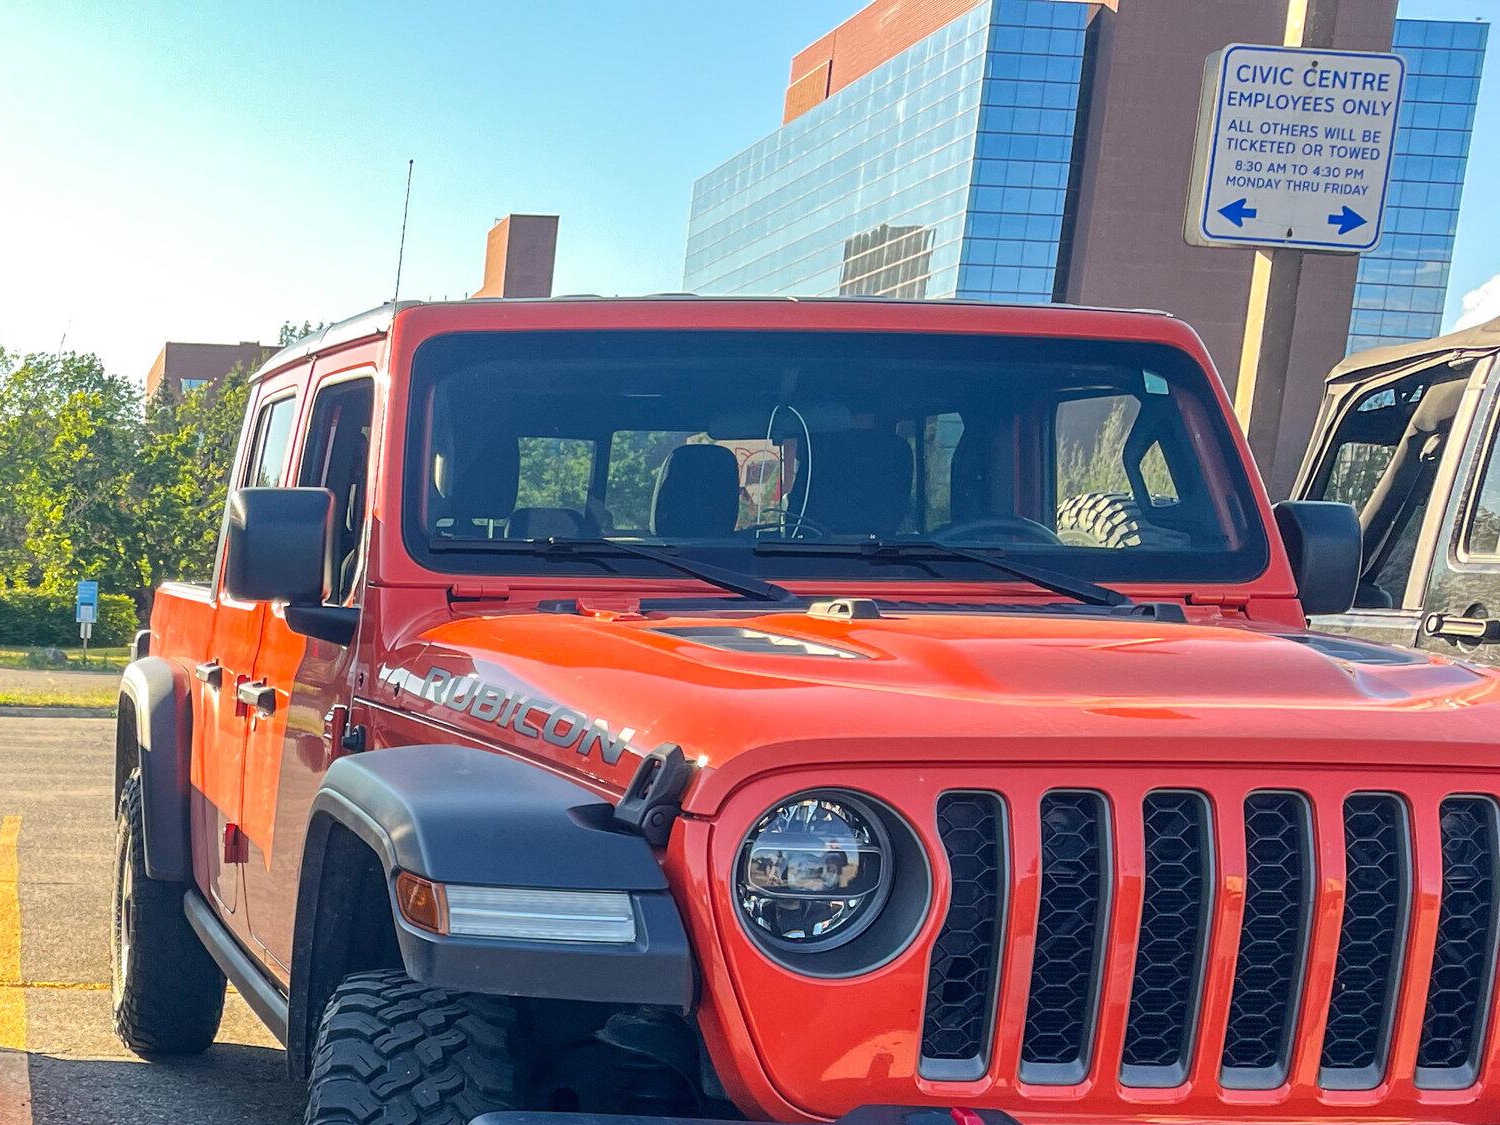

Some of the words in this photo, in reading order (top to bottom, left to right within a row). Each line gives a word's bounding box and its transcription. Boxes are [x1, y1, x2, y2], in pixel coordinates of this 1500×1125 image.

[1236, 64, 1294, 86] CIVIC
[1303, 68, 1390, 92] CENTRE
[1227, 91, 1334, 113] EMPLOYEES
[1343, 99, 1392, 117] ONLY
[1228, 119, 1254, 134] ALL
[1260, 122, 1318, 138] OTHERS
[1324, 128, 1355, 142] WILL
[1362, 130, 1382, 144] BE
[1227, 138, 1296, 155] TICKETED
[1301, 143, 1323, 157] OR
[1329, 145, 1380, 161] TOWED
[1235, 160, 1263, 172] 8:30
[1267, 163, 1287, 174] AM
[1291, 164, 1308, 176] TO
[1312, 166, 1341, 178] 4:30
[1345, 168, 1365, 180] PM
[1226, 175, 1281, 190] MONDAY
[1286, 180, 1320, 192] THRU
[1324, 183, 1370, 197] FRIDAY
[419, 666, 636, 766] RUBICON
